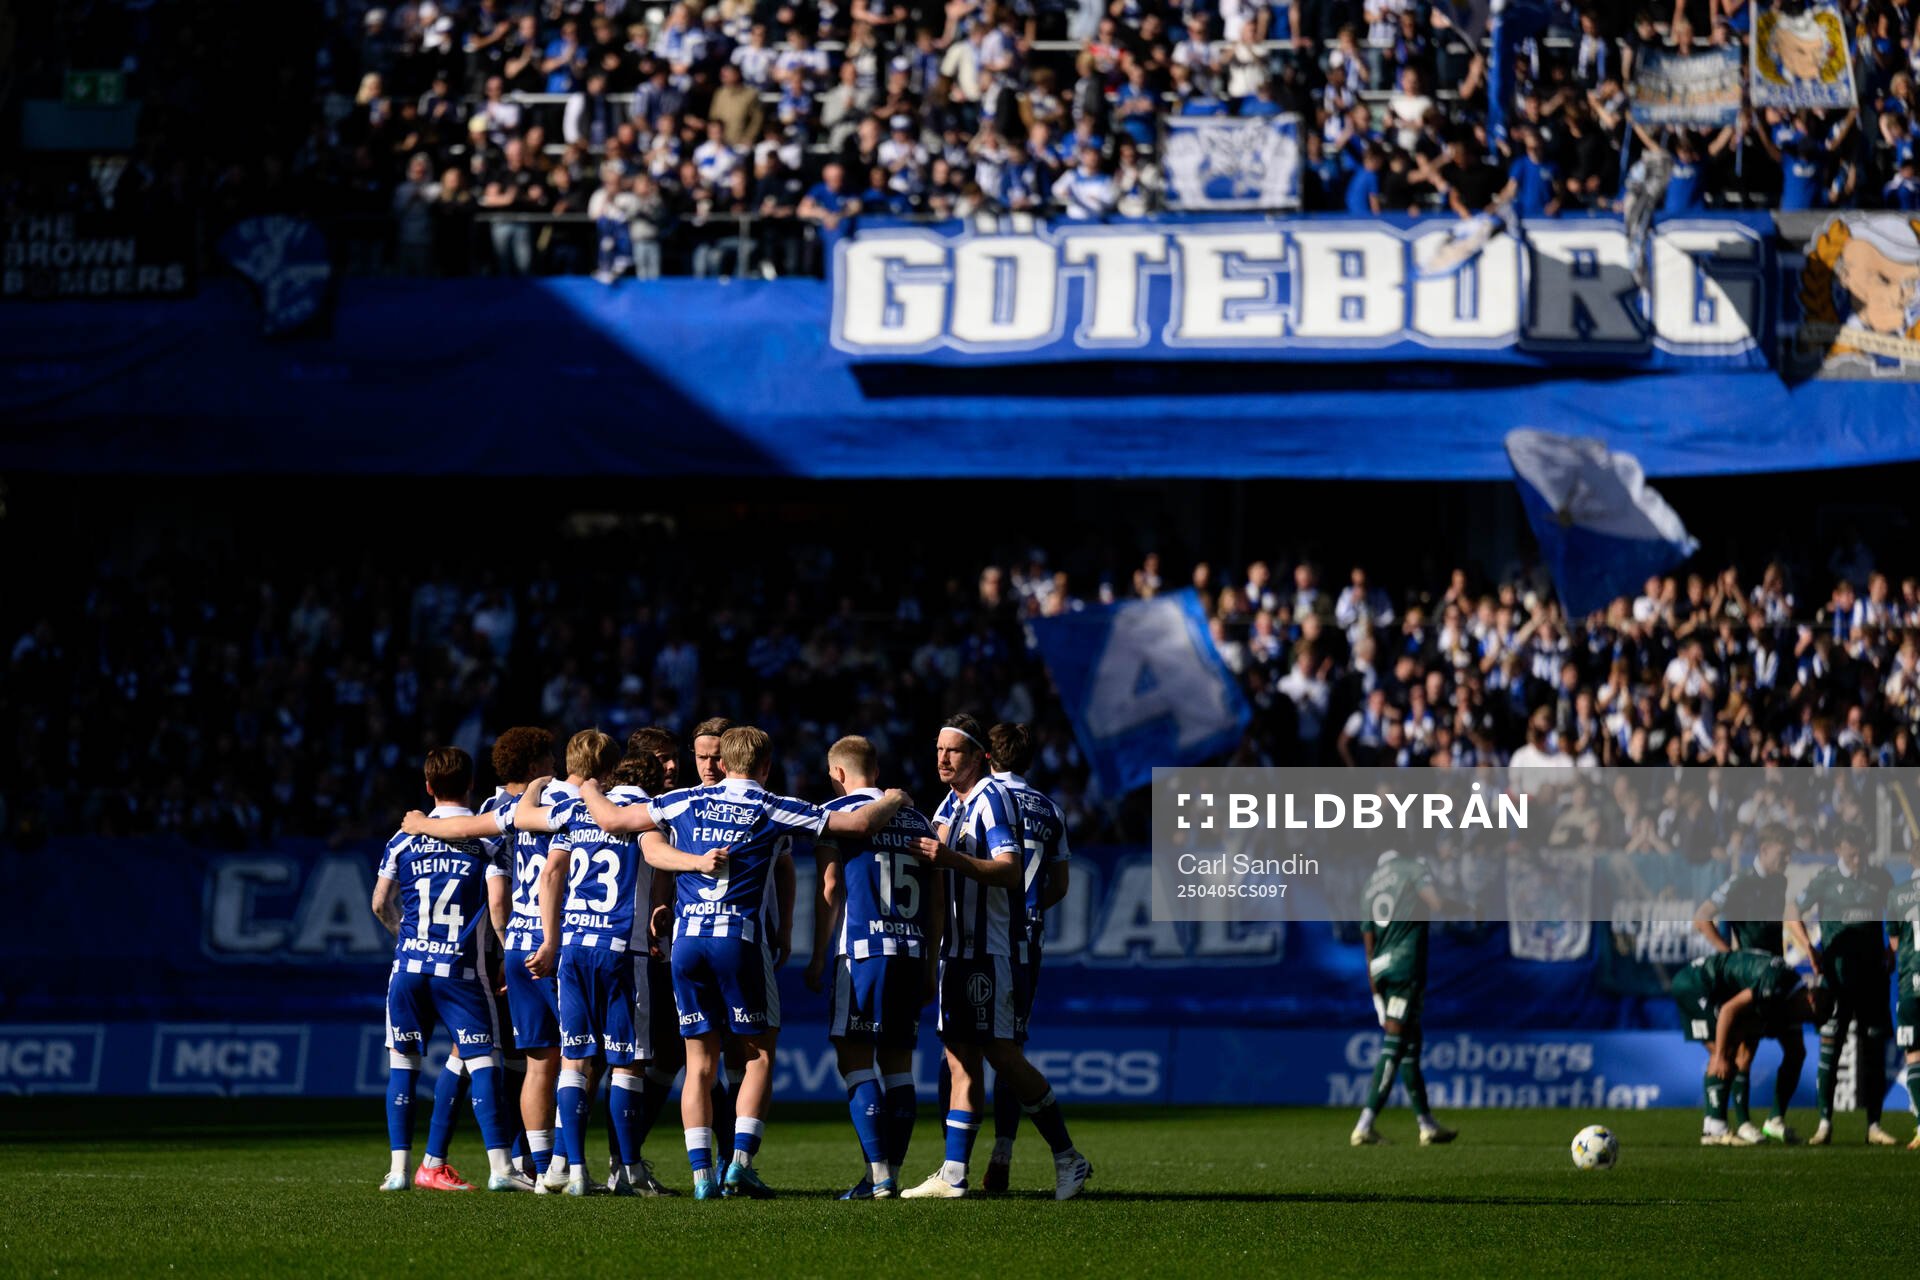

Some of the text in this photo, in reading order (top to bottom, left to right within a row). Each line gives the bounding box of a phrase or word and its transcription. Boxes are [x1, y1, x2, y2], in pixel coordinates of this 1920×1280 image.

[832, 212, 1762, 356] GÖTEBORG
[694, 808, 760, 825] WELLNESS
[706, 801, 755, 816] NORDIC
[693, 827, 754, 843] FENGER
[872, 832, 913, 849] KRUS
[409, 843, 480, 854] WELLNESS
[411, 858, 472, 876] HEINTZ
[564, 847, 621, 913] 23
[874, 852, 920, 919] 15
[415, 877, 464, 942] 14
[683, 902, 741, 917] MOBILL
[869, 919, 925, 938] MOBILL
[402, 937, 463, 956] MOBILL
[459, 1032, 493, 1045] RASTA
[604, 1040, 634, 1053] RASTA
[0, 1041, 74, 1078] CR
[172, 1041, 282, 1079] MCR
[1345, 1033, 1593, 1081] Geborgs
[1327, 1074, 1660, 1109] Mallpartier
